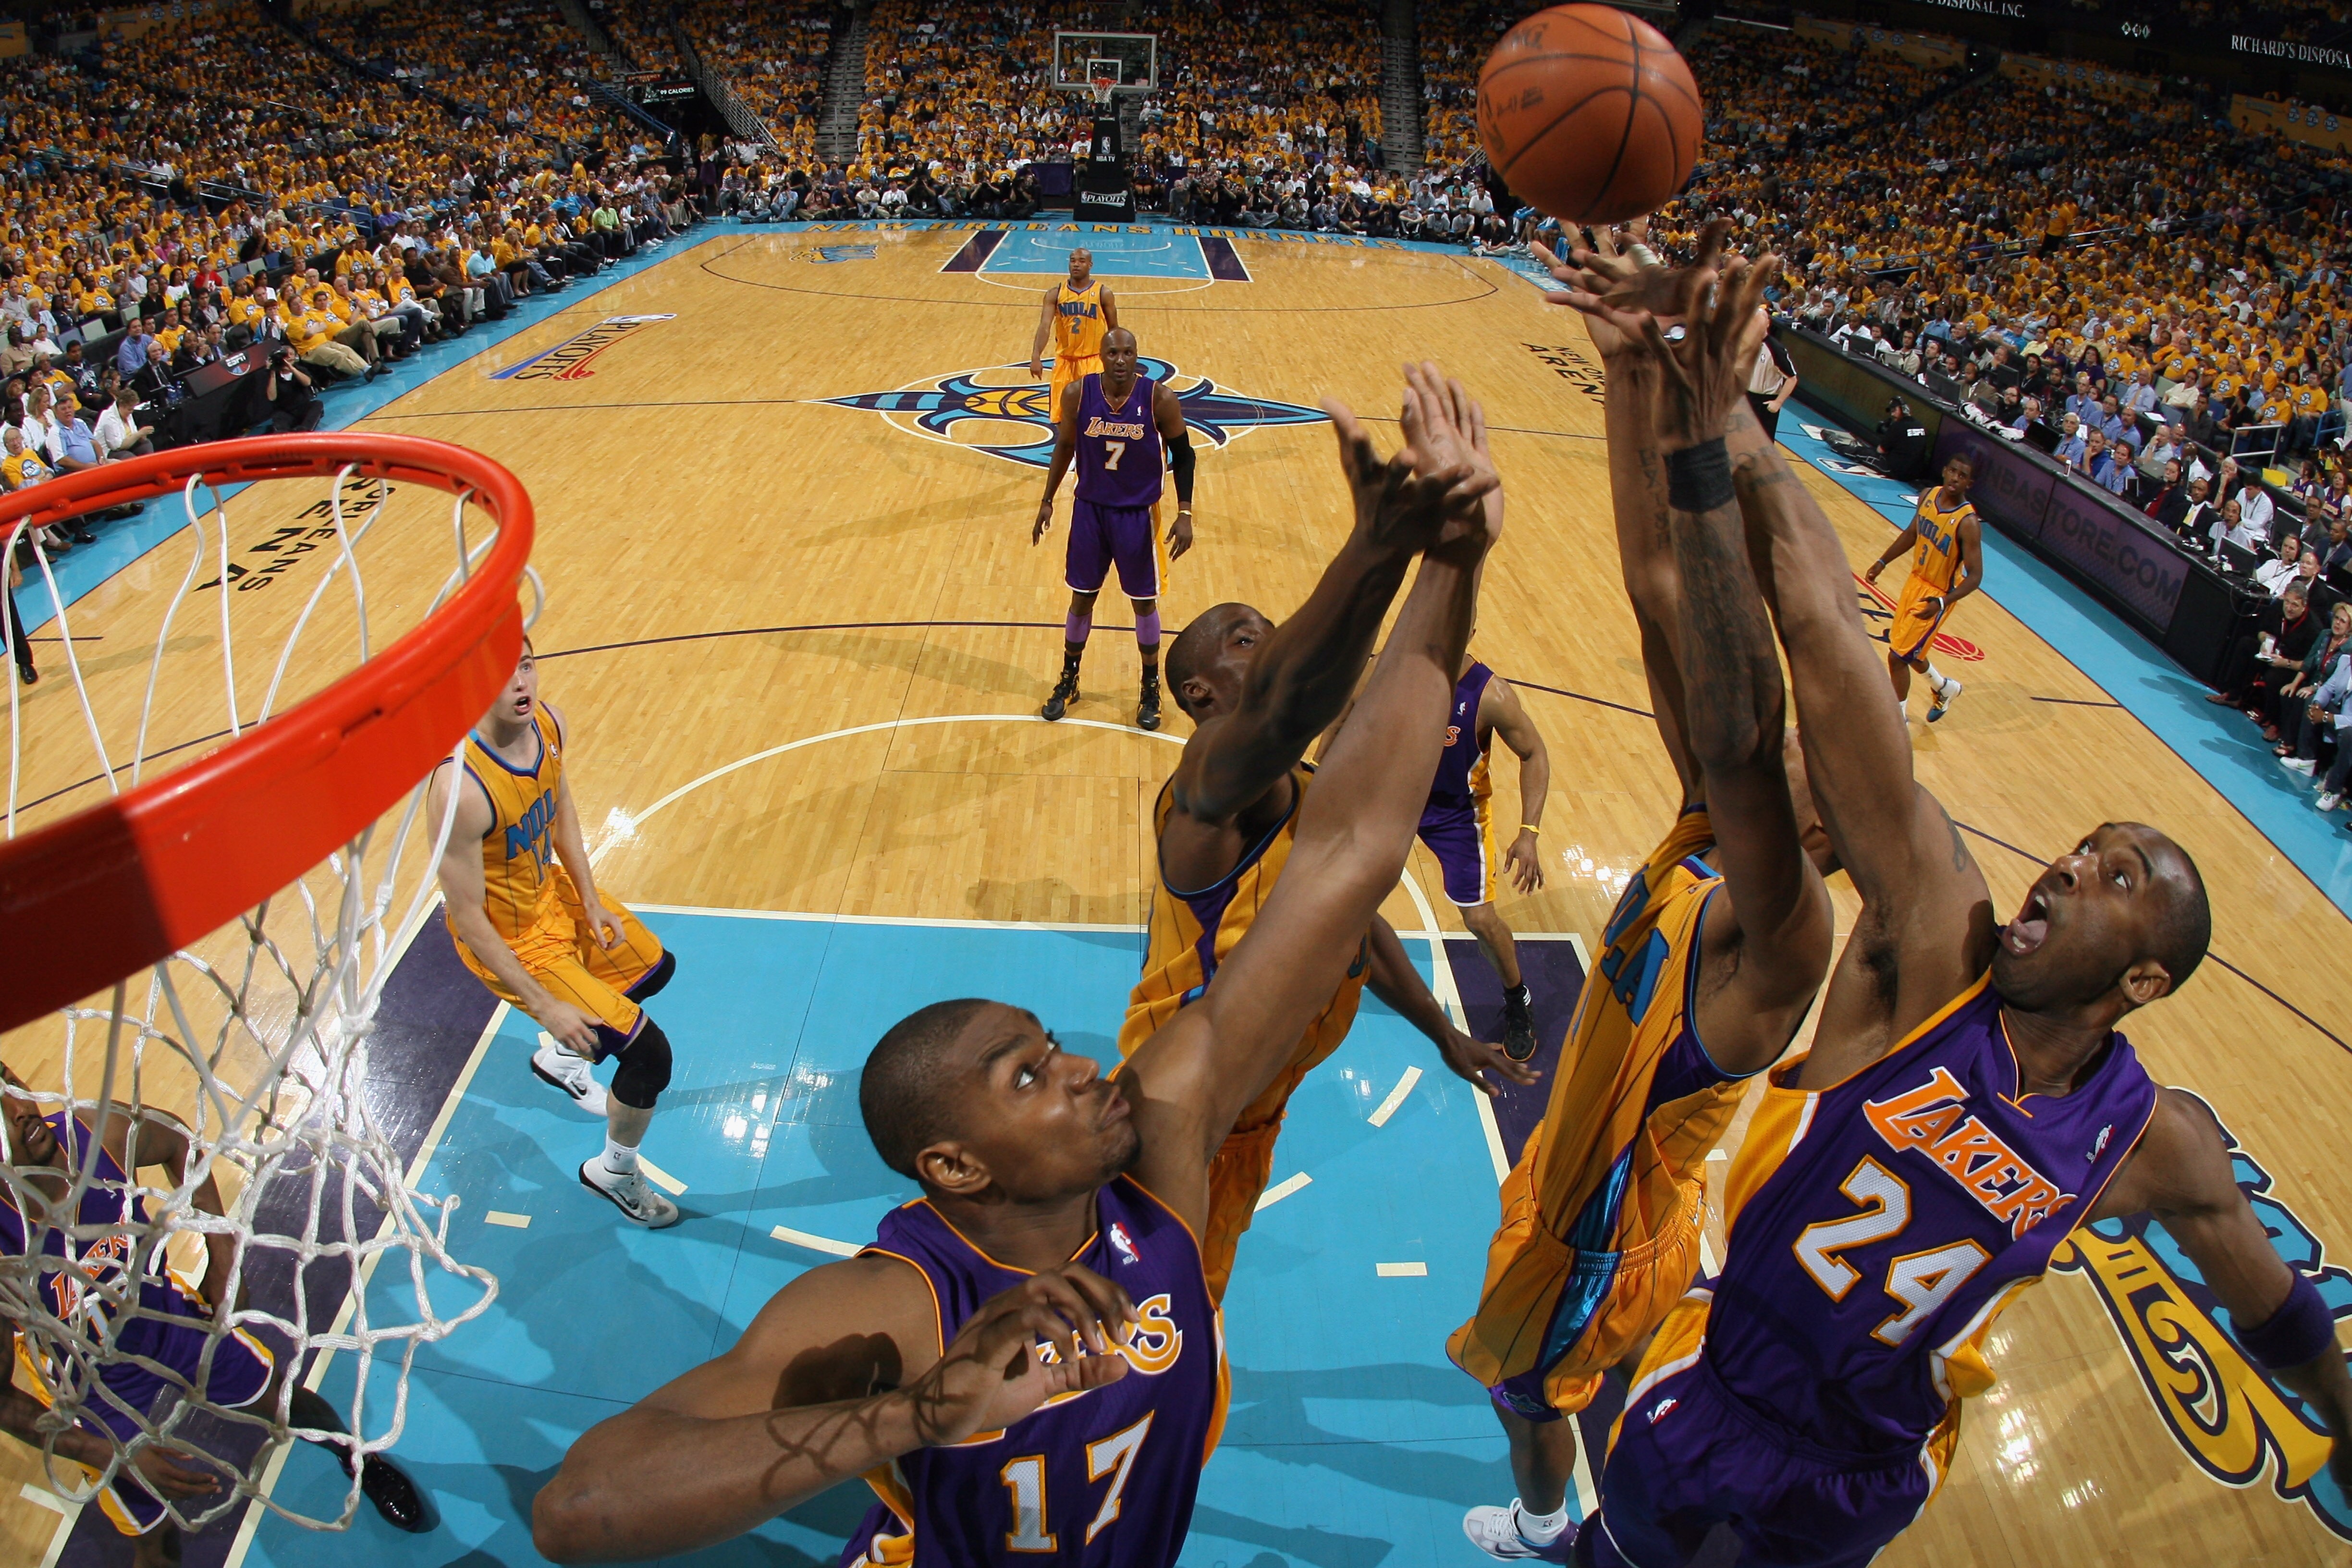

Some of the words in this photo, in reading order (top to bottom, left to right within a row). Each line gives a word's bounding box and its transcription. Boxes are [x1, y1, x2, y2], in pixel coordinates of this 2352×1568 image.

[2002, 3, 2025, 18] INC.
[2231, 35, 2295, 59] RICHARD'S
[1087, 194, 1127, 203] PLAYOFFS
[803, 222, 914, 232] NEW
[926, 222, 1152, 234] ORLEANS
[1173, 227, 1405, 250] HORNETS
[1057, 301, 1098, 320] NOLA
[1071, 317, 1081, 334] 2
[514, 322, 642, 380] PLAYOFFS
[1519, 342, 1605, 409] AREN
[1084, 416, 1145, 440] LAKERS
[1105, 441, 1126, 471] 7
[1919, 544, 1928, 566] 3
[504, 787, 558, 860] NOL
[1792, 1154, 1994, 1347] 24
[1000, 1409, 1155, 1553] 17
